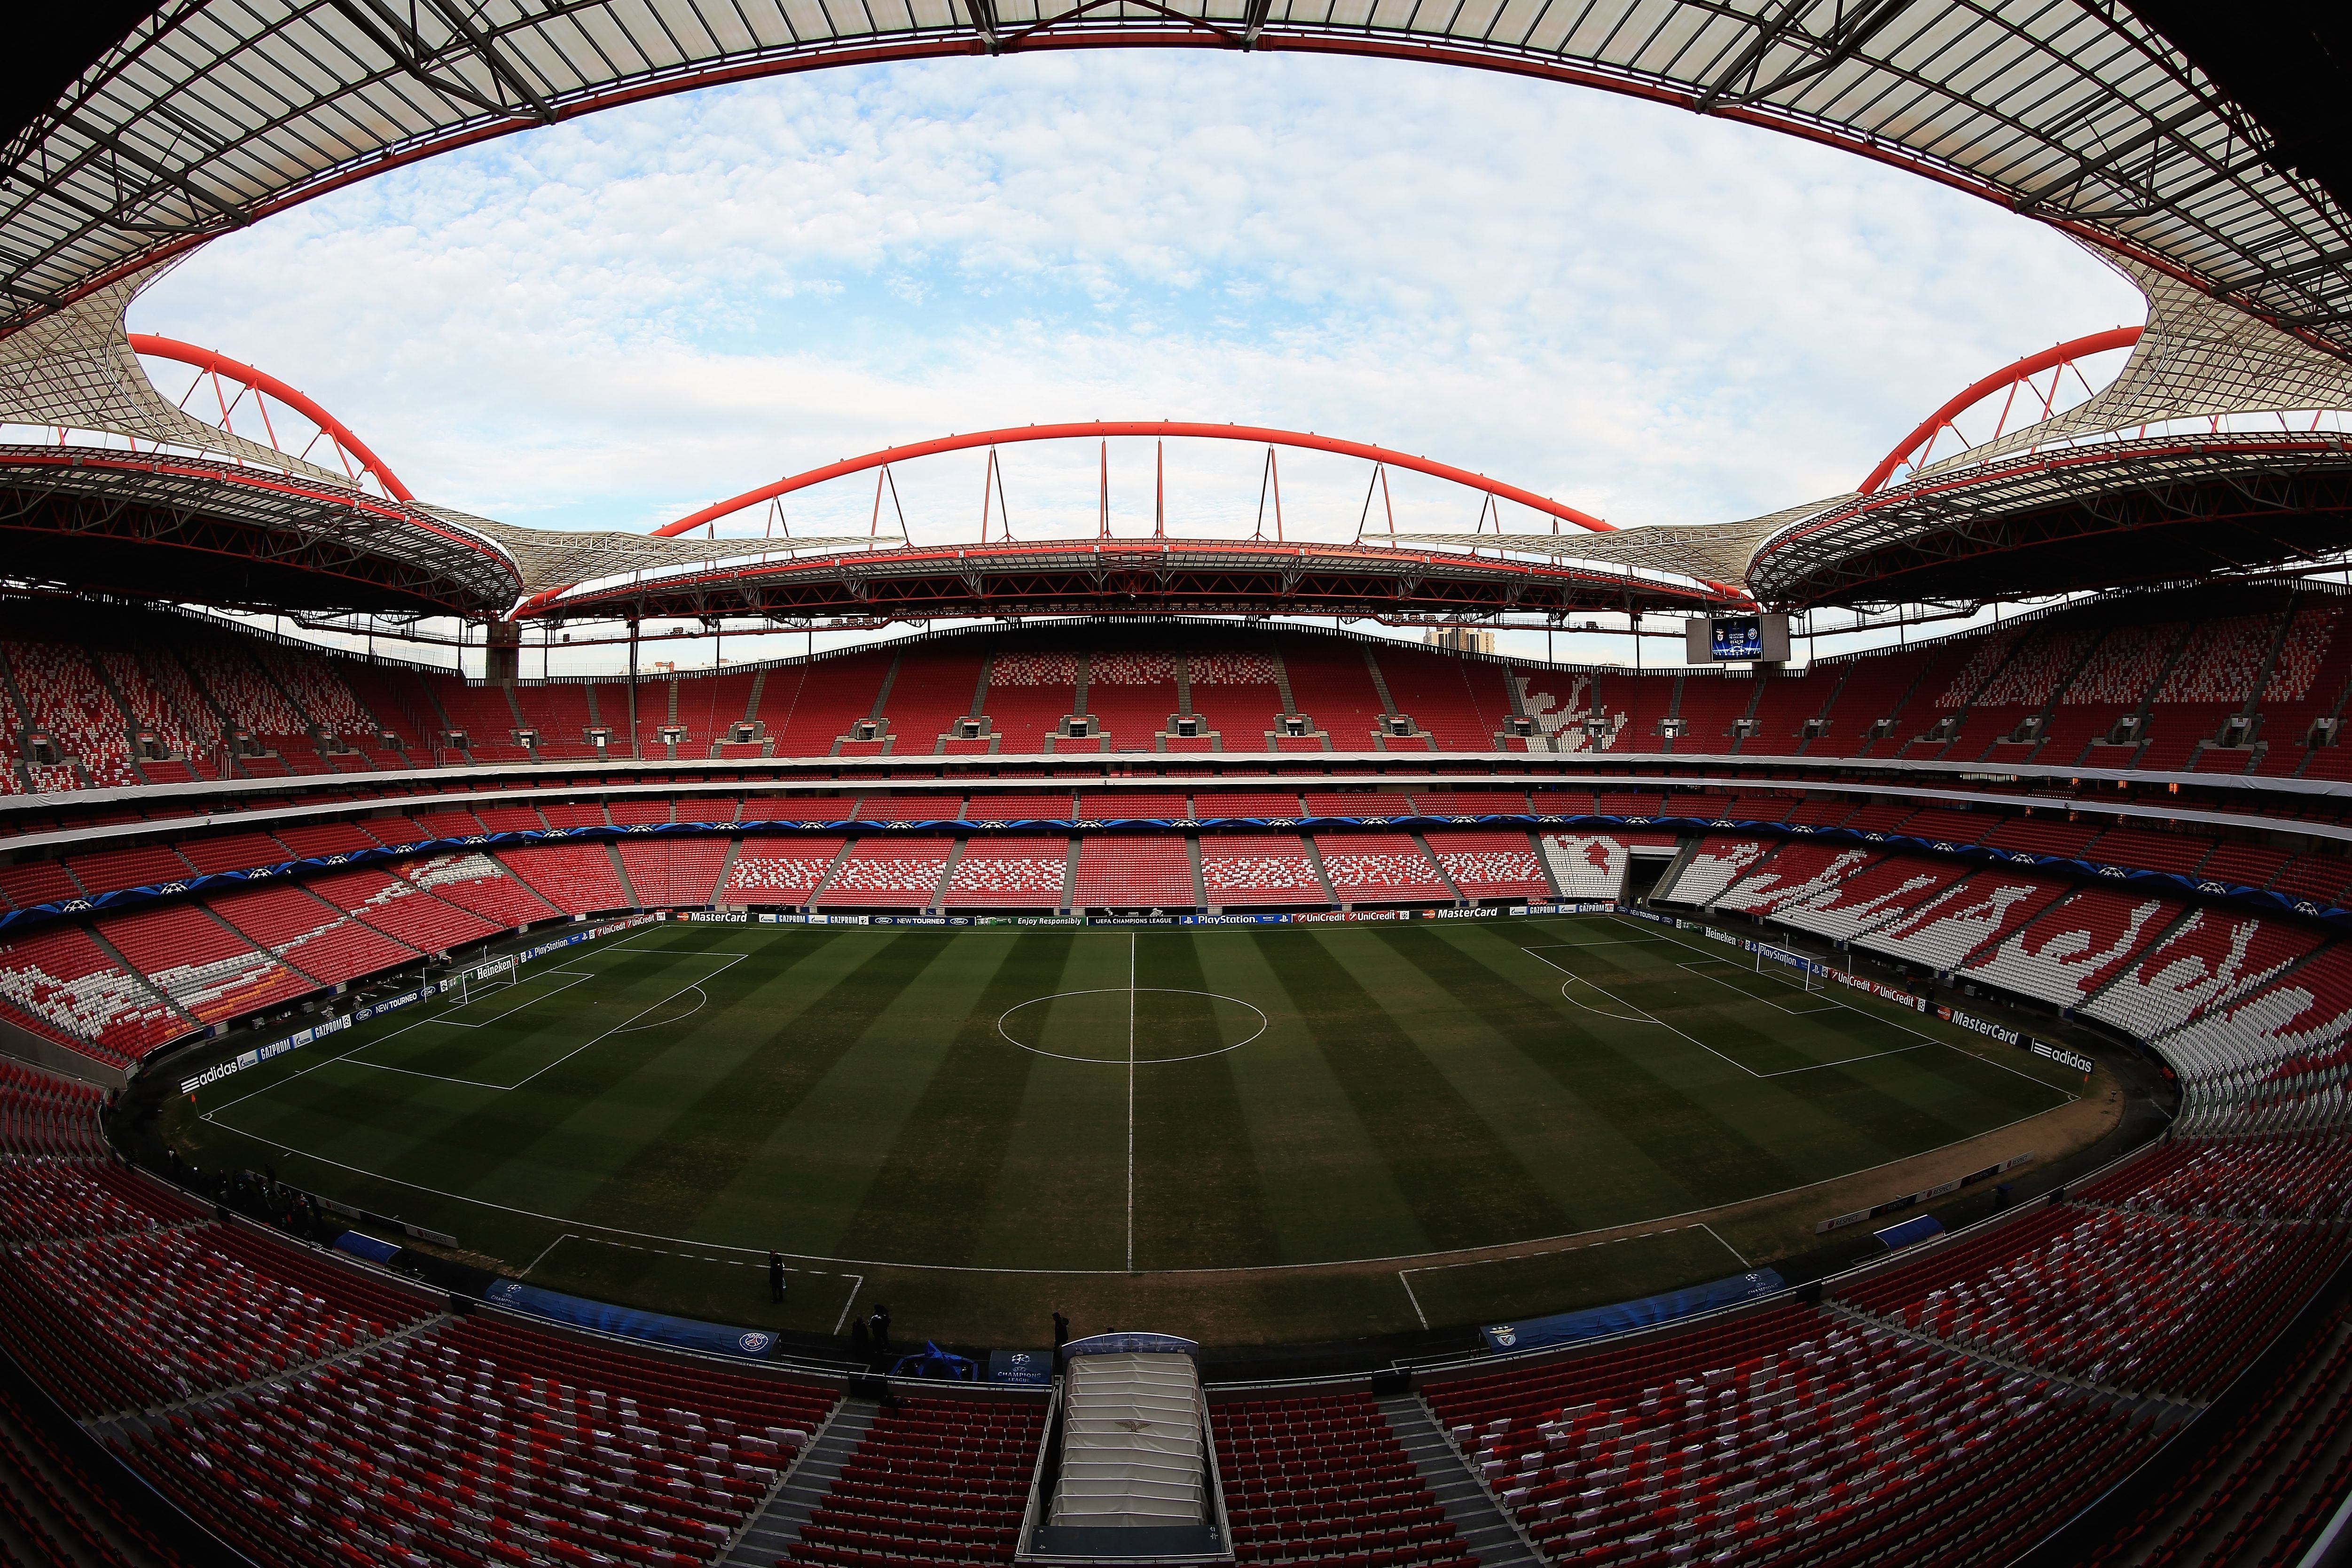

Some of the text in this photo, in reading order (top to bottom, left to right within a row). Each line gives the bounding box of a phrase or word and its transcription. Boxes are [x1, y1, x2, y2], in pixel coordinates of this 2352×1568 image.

[691, 913, 747, 922] MasterCard
[1358, 912, 1395, 920] UniCredit
[1437, 908, 1498, 918] MasterCard
[1640, 911, 1659, 921] TOURNEO
[632, 914, 655, 926] UniCredit
[603, 922, 626, 934] UniCredit
[1705, 926, 1736, 945] Heineken
[477, 960, 511, 980] Heineken
[1838, 972, 1870, 992] UniCredit
[1880, 986, 1914, 1007] UniCredit
[376, 993, 417, 1014] NEW TOURNEO
[315, 1018, 343, 1038] GAZPROM
[1952, 1011, 2018, 1045] MasterCard
[260, 1038, 290, 1059] GAZPROM
[2052, 1050, 2092, 1072] adidas
[200, 1061, 237, 1085] adidas
[2012, 1155, 2028, 1164] RESPECT
[1933, 1184, 1952, 1194] RESPECT
[331, 1203, 350, 1214] RESPECT
[1887, 1199, 1908, 1211] RESPECT
[1835, 1215, 1858, 1226] RESPECT
[424, 1232, 447, 1243] RESPECT
[1748, 1283, 1778, 1295] CHAMPIONS
[491, 1295, 520, 1306] CHAMPIONS
